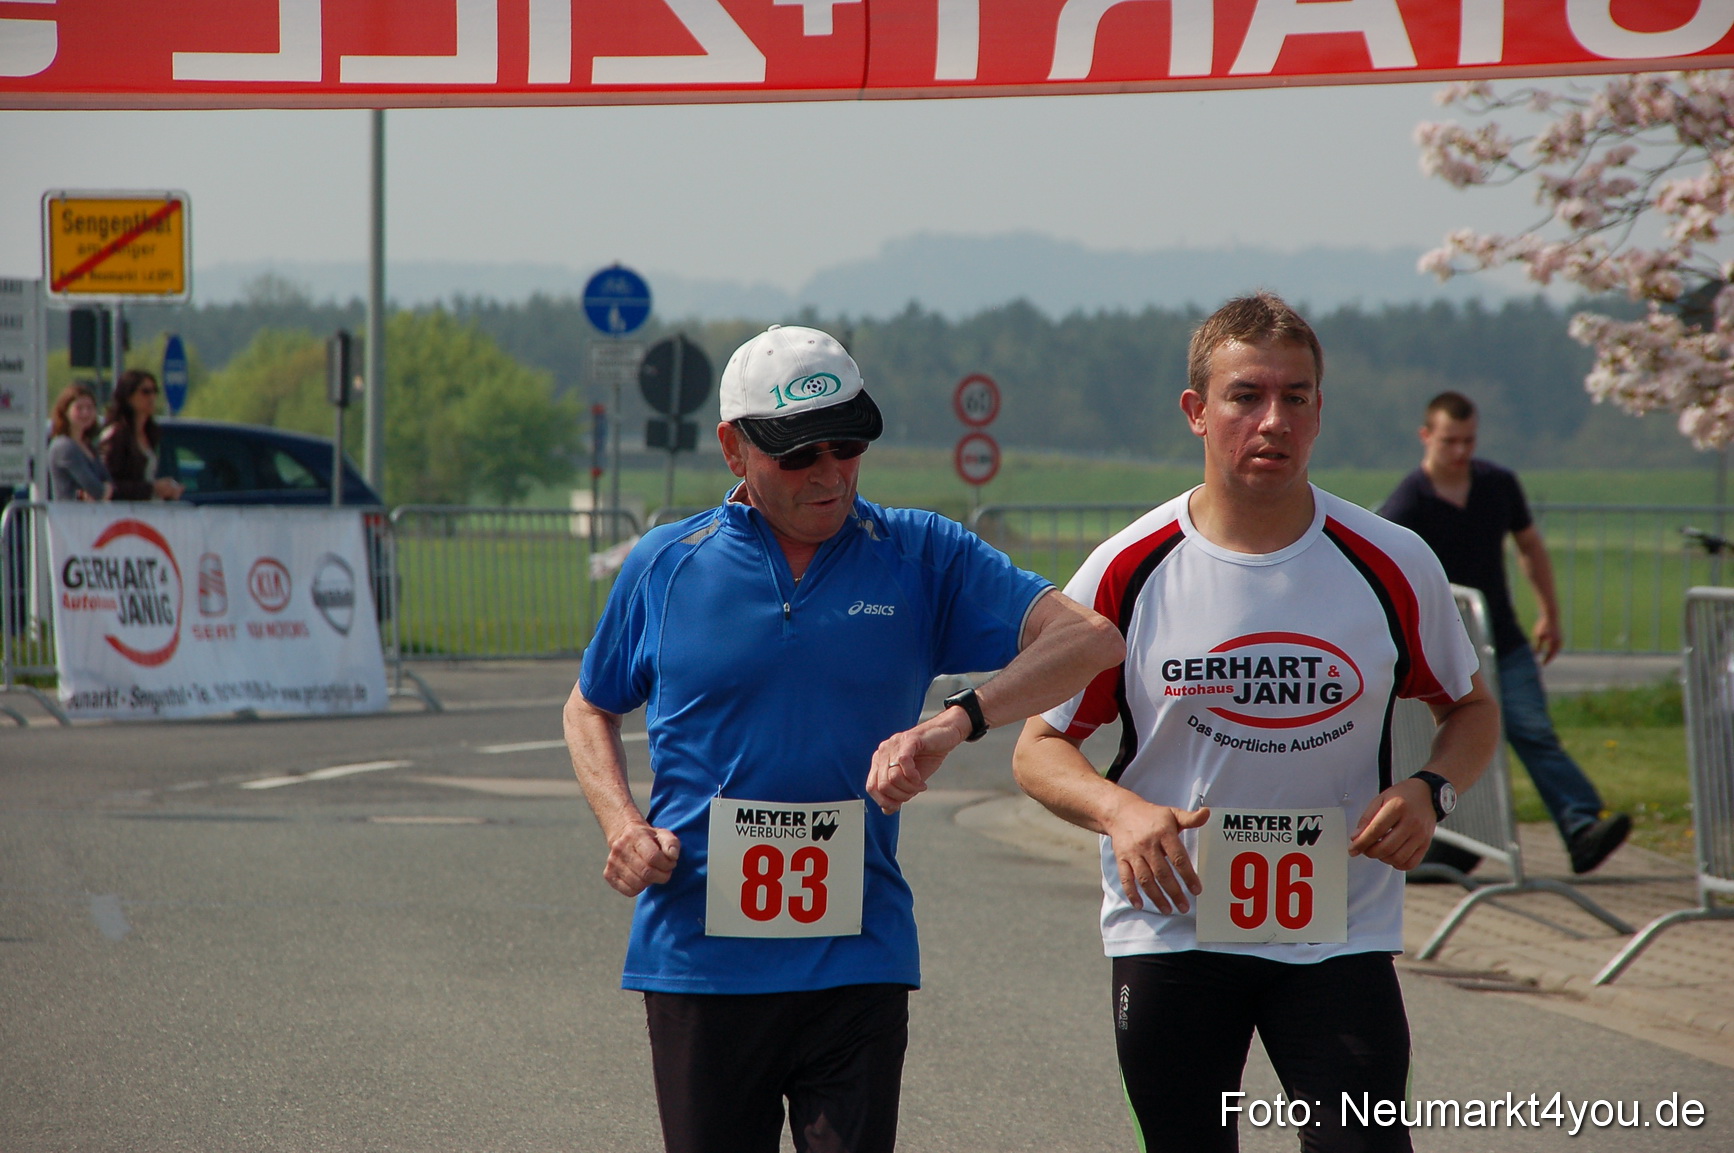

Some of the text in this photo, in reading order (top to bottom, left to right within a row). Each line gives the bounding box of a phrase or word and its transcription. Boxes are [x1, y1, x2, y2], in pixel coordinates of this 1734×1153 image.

[62, 556, 157, 590] GERHART
[62, 592, 117, 611] Auto
[864, 604, 895, 616] asics
[1161, 656, 1340, 682] GERHART &
[1164, 683, 1234, 696] Autohaus
[1233, 681, 1343, 705] JÄNIG
[1187, 714, 1355, 754] Das sportliche Autohaus
[735, 808, 807, 827] MEYER
[1223, 814, 1292, 831] MEYER
[735, 825, 807, 839] WERBUNG
[1223, 831, 1293, 843] WERBUNG
[740, 844, 829, 924] 83
[1230, 851, 1314, 930] 96
